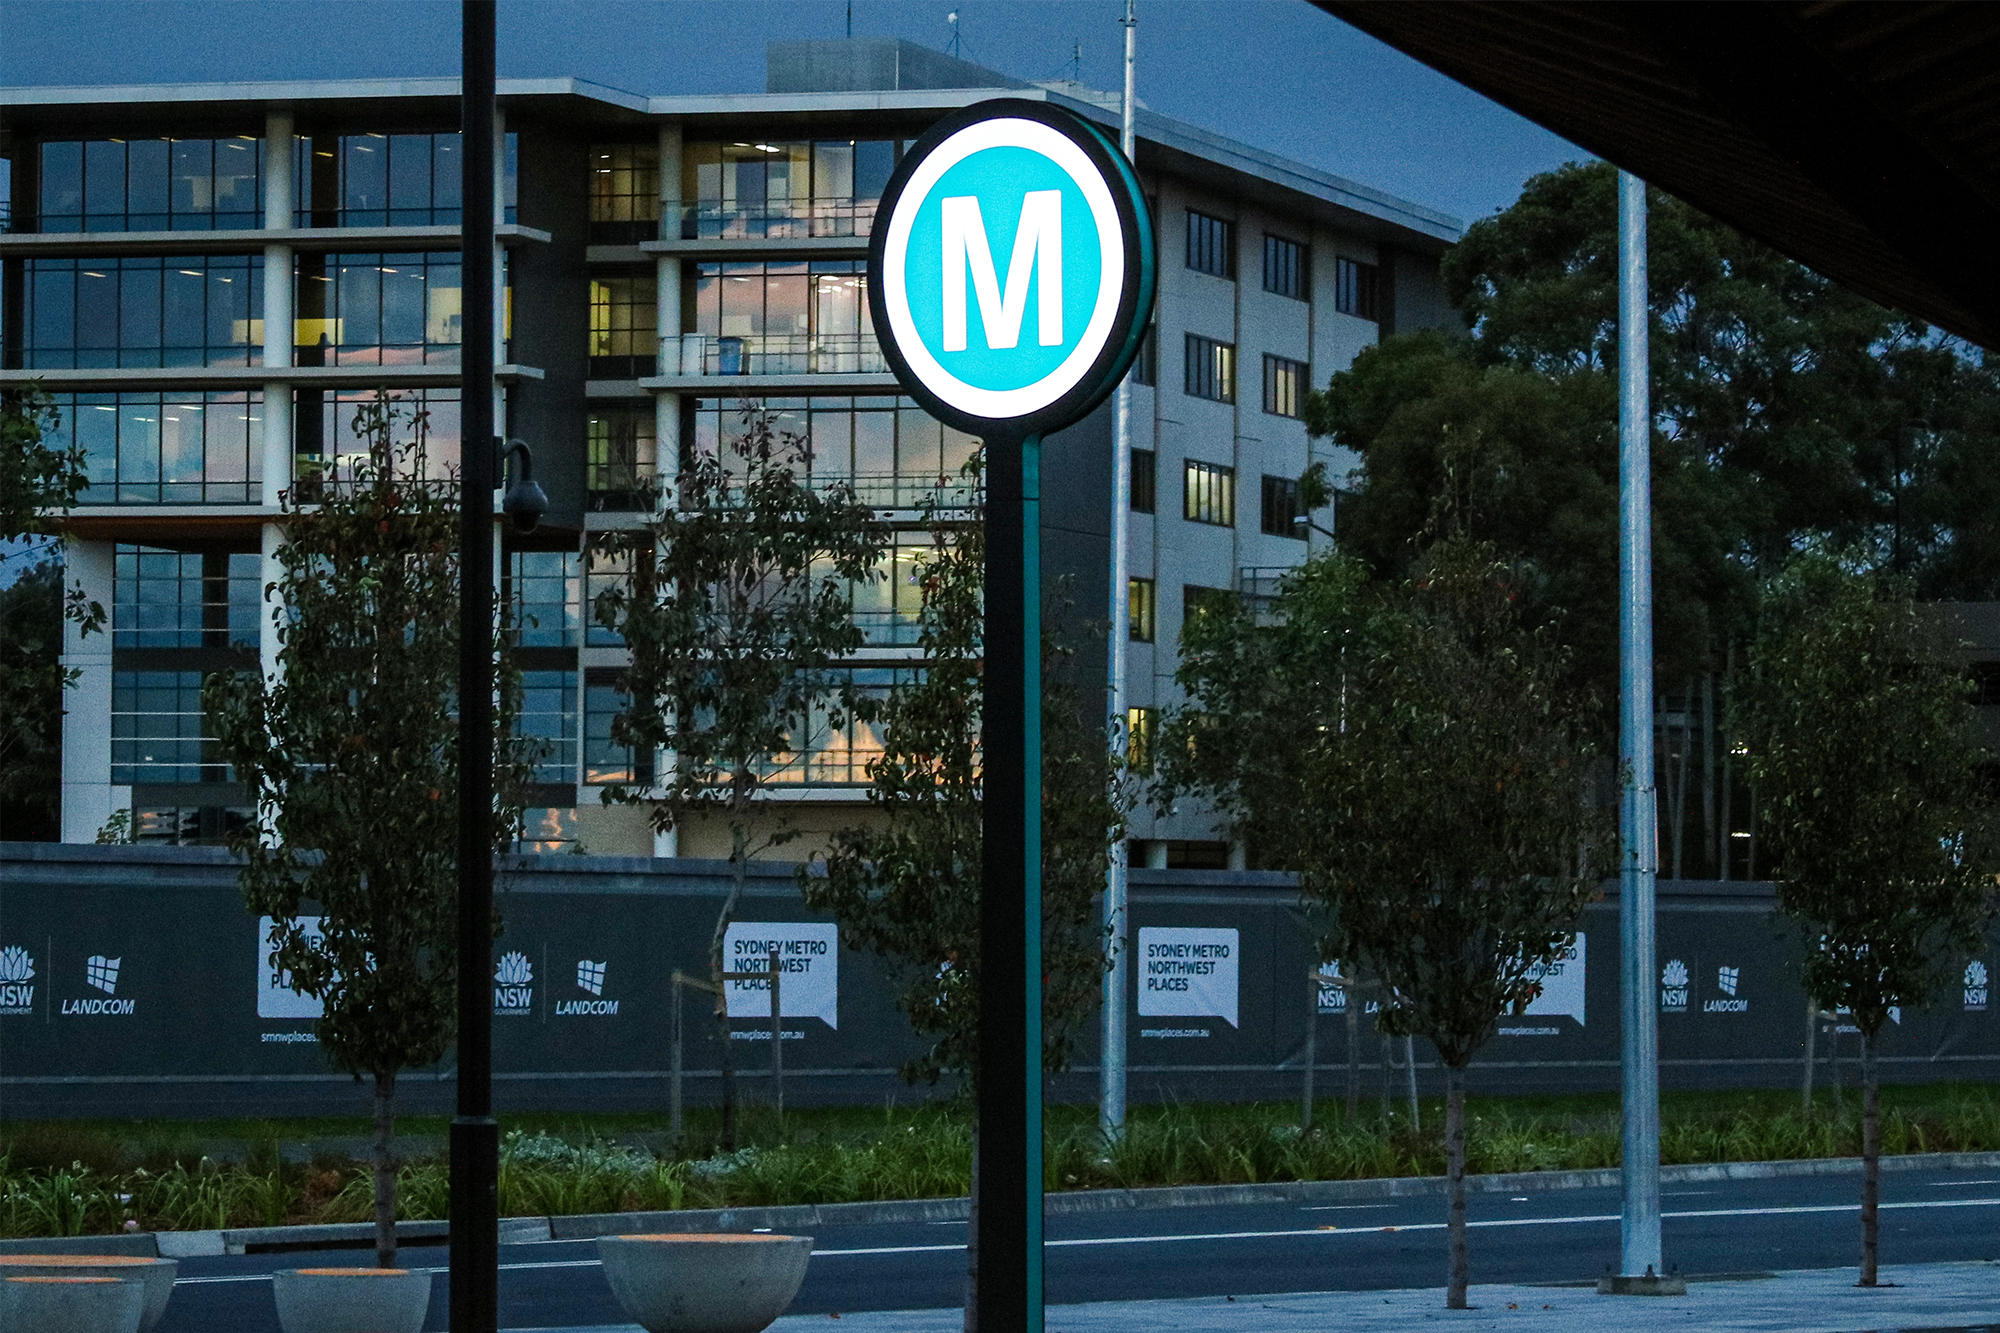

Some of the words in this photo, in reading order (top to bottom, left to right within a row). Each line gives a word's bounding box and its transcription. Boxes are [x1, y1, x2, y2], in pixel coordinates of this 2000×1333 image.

[942, 189, 1063, 352] M
[735, 940, 783, 954] SYDNEY
[786, 940, 827, 954] METRO
[1148, 944, 1191, 957] SYDNEY
[1193, 944, 1230, 958] METRO
[735, 958, 811, 972] NORTWEST
[1148, 961, 1216, 975] NORTHWEST
[735, 979, 772, 990] PLACE
[1148, 978, 1189, 991] PLACES
[495, 988, 532, 1008] NSW
[1318, 989, 1346, 1007] NSW
[1661, 989, 1688, 1006] NSW
[1964, 988, 1988, 1004] NSW
[61, 999, 136, 1015] LANDCOM
[555, 1000, 619, 1015] LANDCOM
[1703, 999, 1749, 1012] LANDCOM
